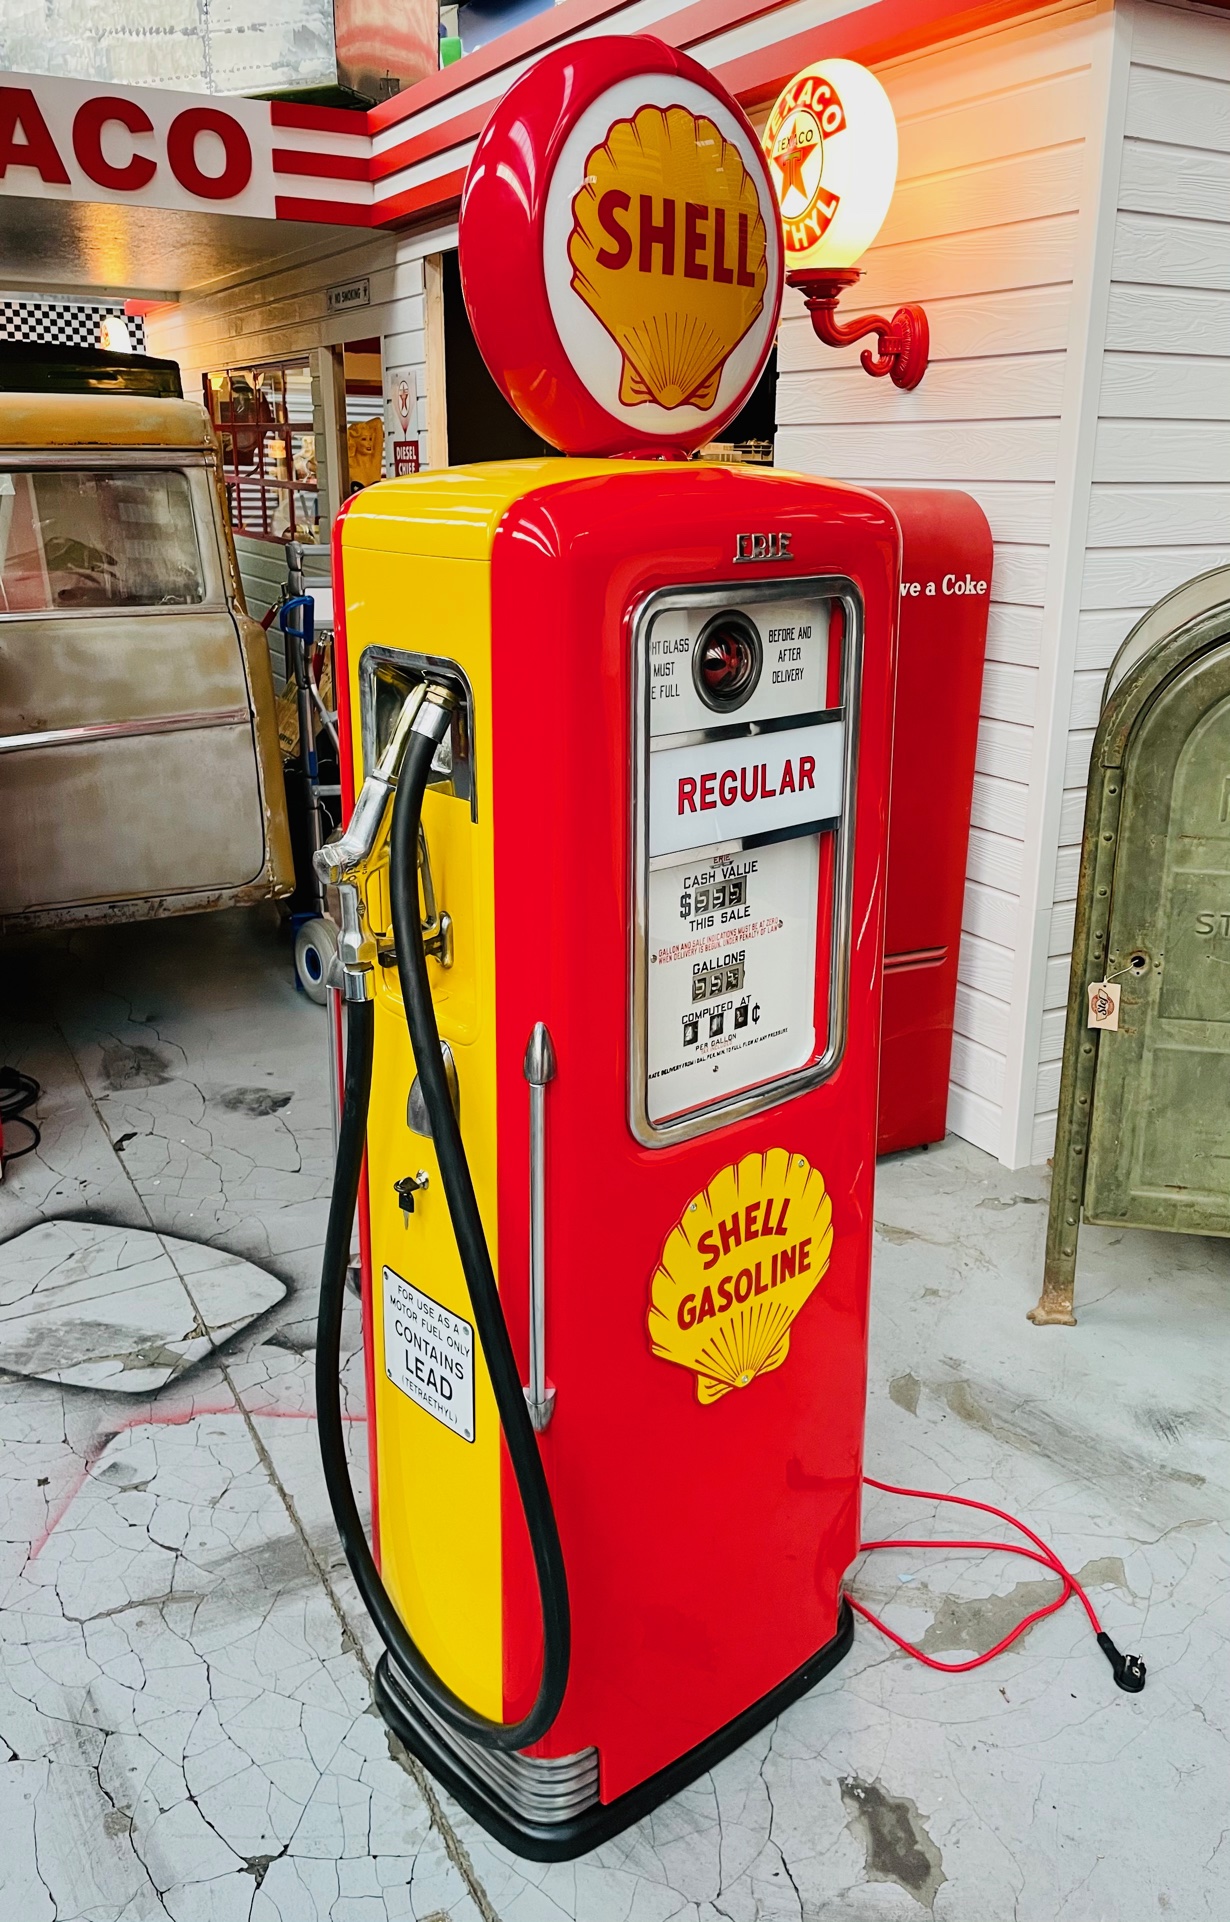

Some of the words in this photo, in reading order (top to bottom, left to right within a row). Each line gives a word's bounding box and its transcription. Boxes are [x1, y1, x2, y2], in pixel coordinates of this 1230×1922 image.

[764, 79, 842, 151] TEXACO
[777, 129, 814, 152] TEXACO
[595, 188, 756, 288] SHELL
[396, 445, 417, 460] DIESEL
[733, 532, 794, 563] ERIE
[925, 582, 936, 596] a
[942, 574, 988, 596] Coke
[662, 638, 690, 655] GLASS
[768, 626, 796, 644] BEFORE
[797, 625, 812, 640] AND
[777, 647, 802, 663] AFTER
[653, 661, 676, 678] MUST
[772, 667, 805, 685] DELIVERY
[659, 683, 681, 699] FULL
[677, 755, 816, 816] REGULAR
[713, 853, 731, 864] ERIE
[683, 870, 716, 890] CASH
[721, 860, 759, 879] VALUE
[688, 915, 715, 932] THIS
[720, 905, 751, 924] SALE
[658, 944, 680, 957] GALLON
[680, 940, 692, 951] AND
[692, 937, 706, 948] SALE
[673, 948, 697, 961] DELIVERY
[692, 950, 746, 976] GALLONS
[681, 1000, 734, 1025] COMPUTED
[740, 994, 752, 1006] AT
[695, 1042, 709, 1052] PER
[711, 1033, 737, 1047] GALLON
[660, 1064, 682, 1076] DELIVERY
[696, 1197, 791, 1271] SHELL
[677, 1236, 812, 1331] GASOLINE
[397, 1284, 414, 1304] FOR
[416, 1296, 435, 1319] USE
[437, 1311, 451, 1330] AS
[453, 1322, 460, 1335] A
[389, 1294, 418, 1324] MOTOR
[421, 1318, 444, 1342] FUEL
[446, 1335, 470, 1358] ONLY
[394, 1319, 464, 1381] CONTAINS
[404, 1348, 453, 1401] LEAD
[401, 1374, 458, 1425] (TETRAETHYL)
